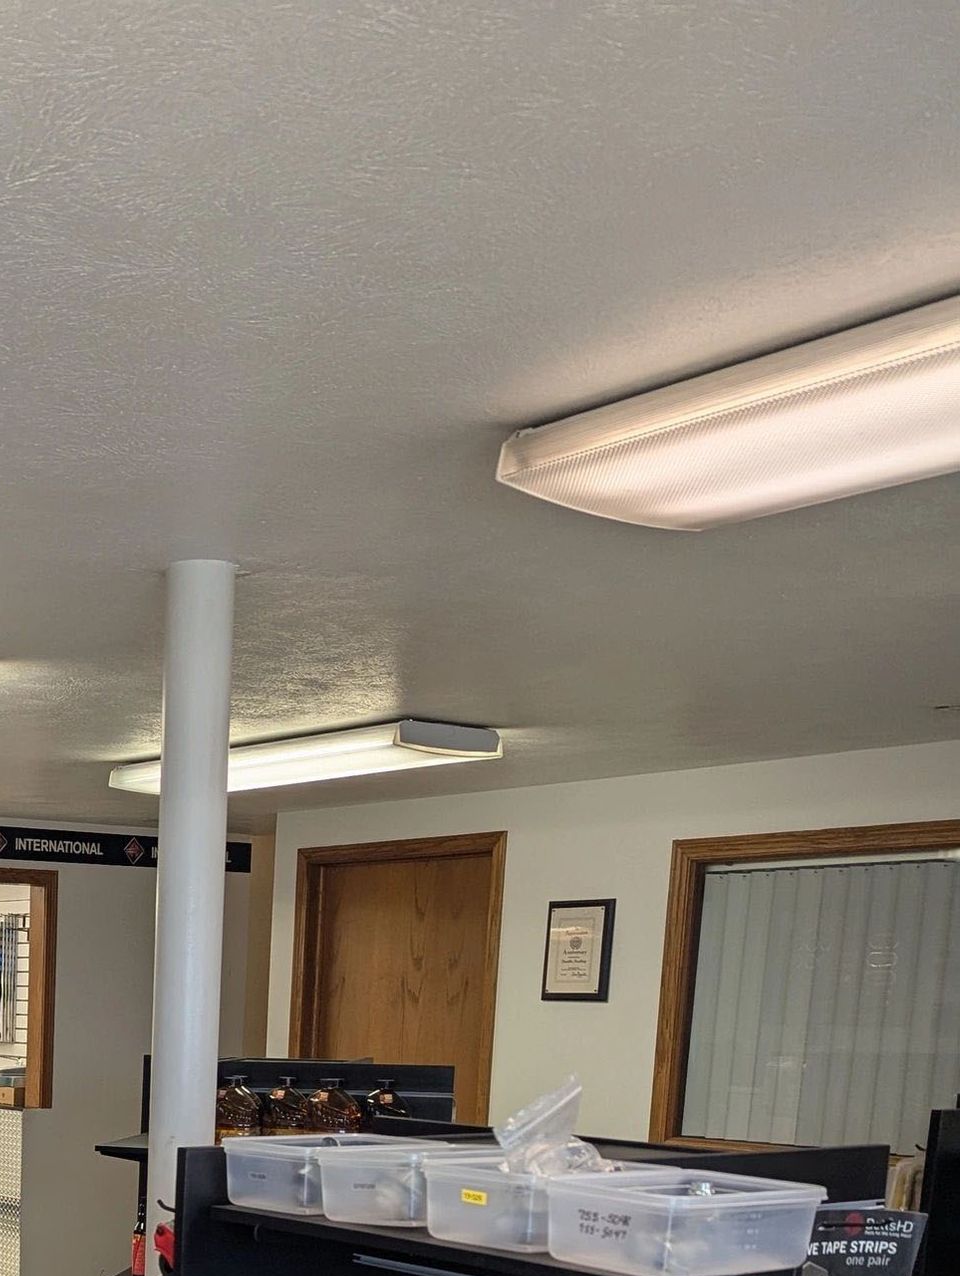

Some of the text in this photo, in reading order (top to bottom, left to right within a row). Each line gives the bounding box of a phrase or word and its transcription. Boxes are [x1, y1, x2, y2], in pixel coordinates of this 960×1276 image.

[15, 837, 104, 856] INTERNATIONAL
[821, 1241, 847, 1255] TAPE
[850, 1240, 898, 1255] STRIPS
[845, 1254, 891, 1268] one pair
